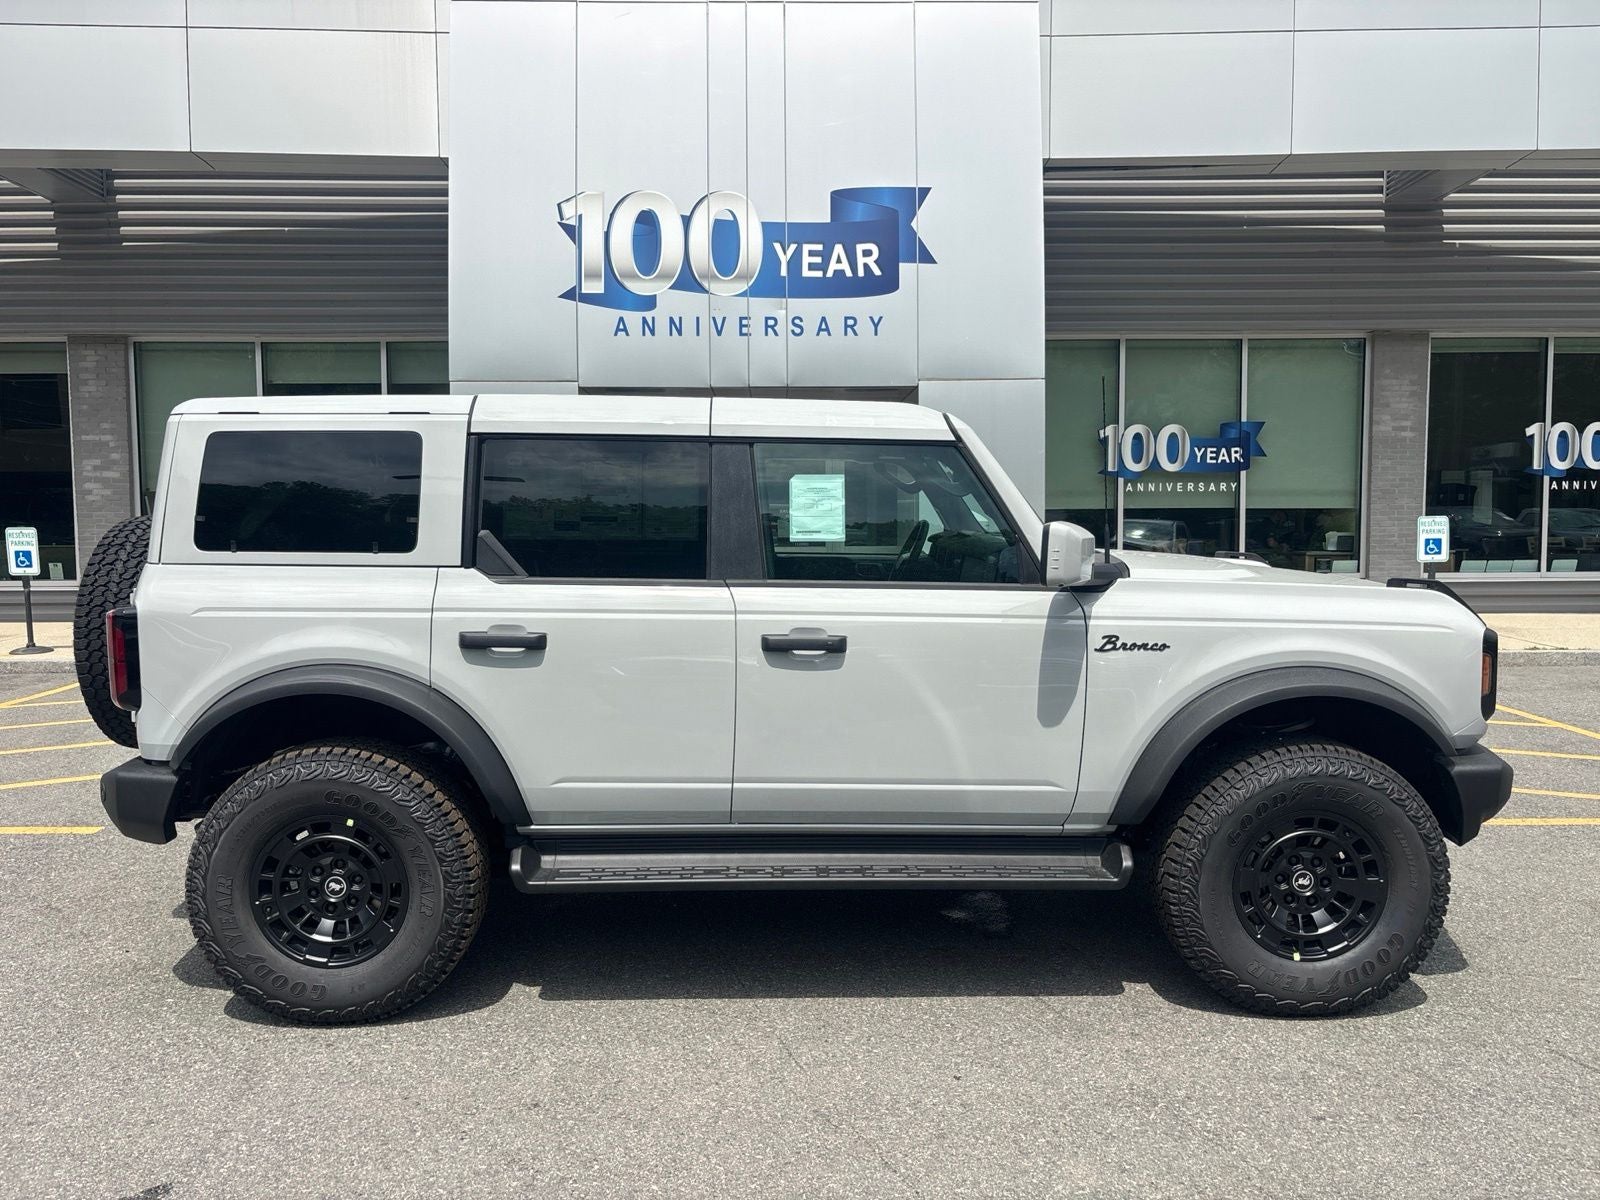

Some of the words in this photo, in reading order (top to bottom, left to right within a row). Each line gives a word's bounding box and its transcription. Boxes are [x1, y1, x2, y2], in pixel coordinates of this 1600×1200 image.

[556, 189, 764, 297] 100
[772, 241, 883, 279] YEAR
[613, 315, 885, 338] ANNIVERSARY
[1098, 423, 1191, 473] 100
[1193, 446, 1245, 464] YEAR
[1524, 421, 1600, 471] 100
[1125, 481, 1239, 493] ANNIVERSARY
[1093, 634, 1171, 653] Bronco
